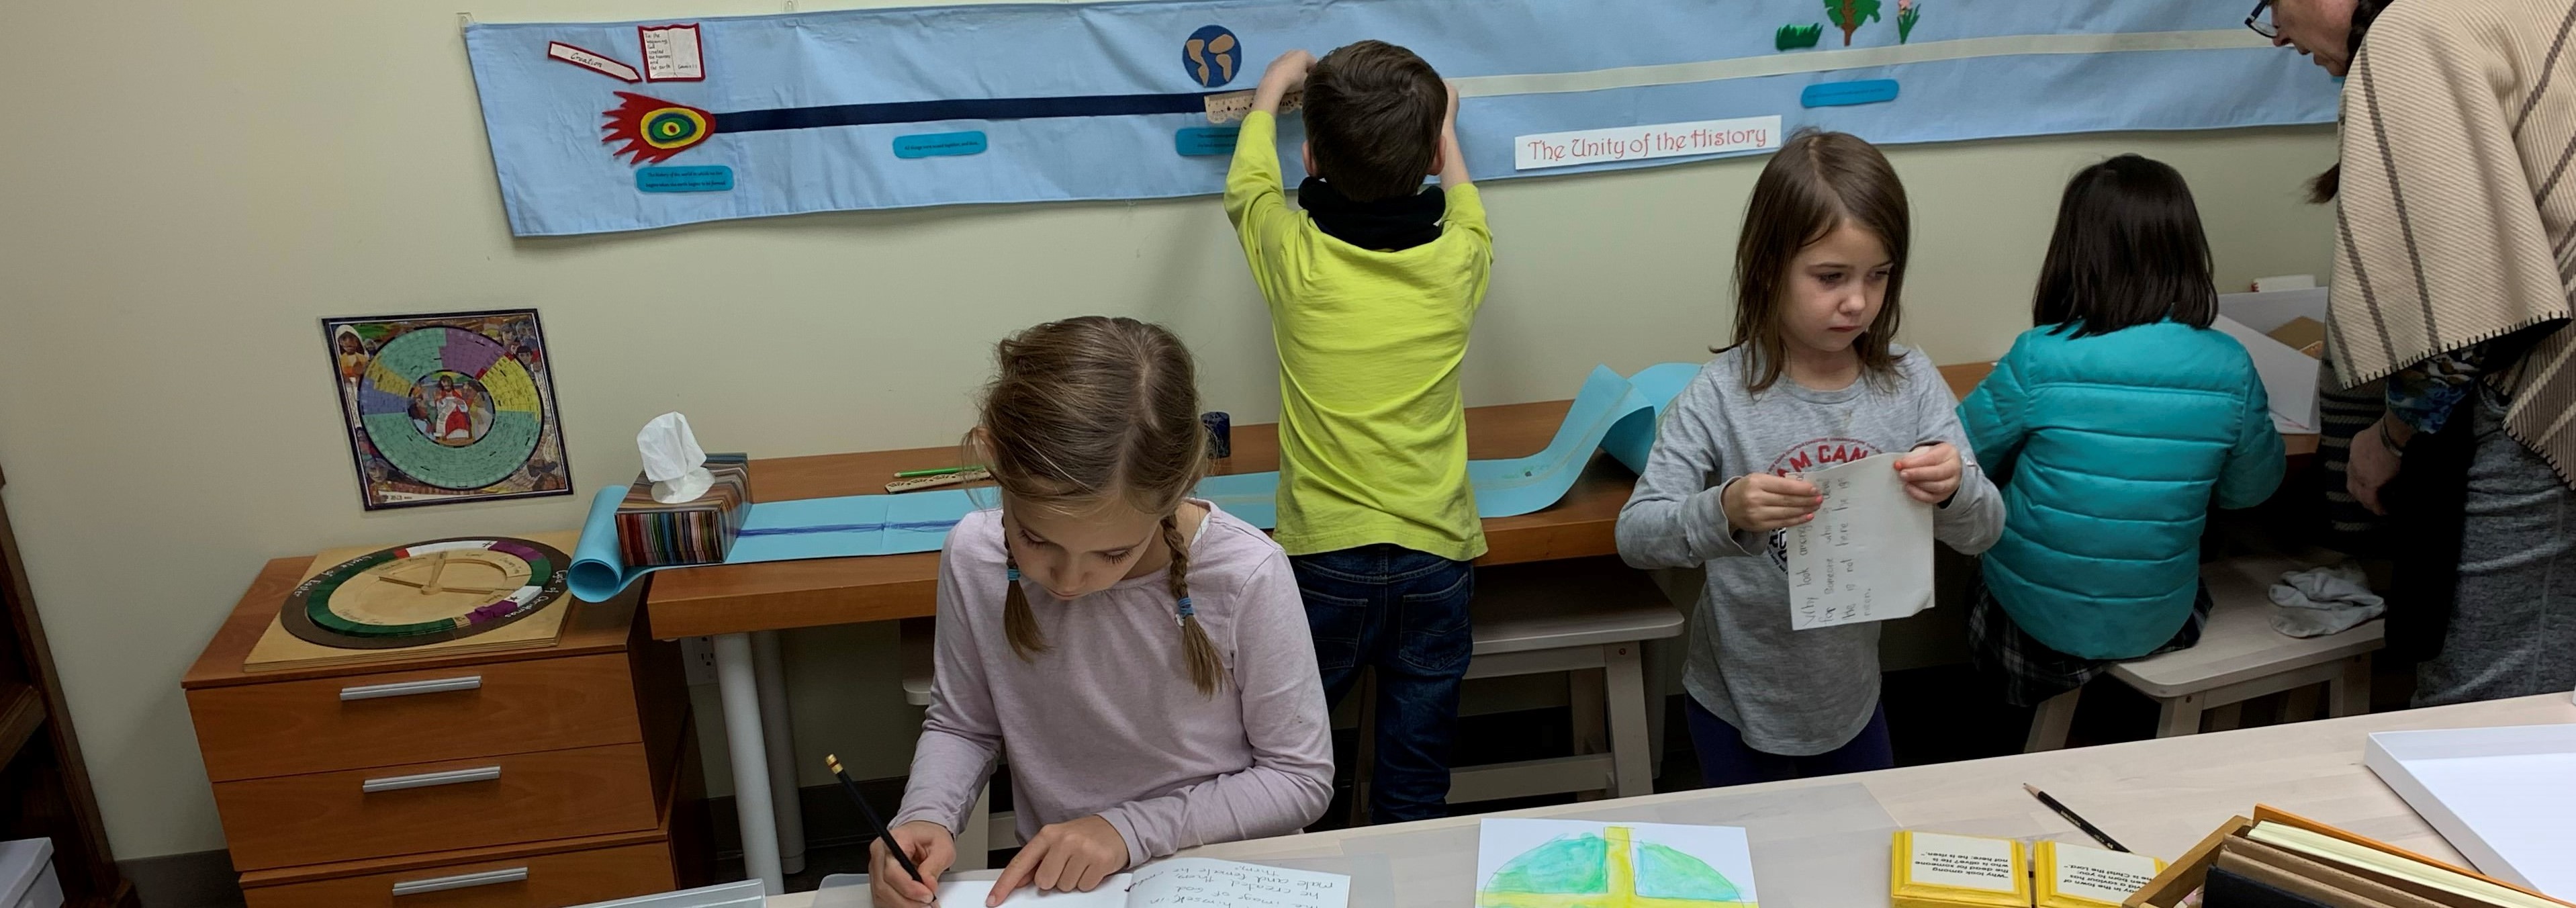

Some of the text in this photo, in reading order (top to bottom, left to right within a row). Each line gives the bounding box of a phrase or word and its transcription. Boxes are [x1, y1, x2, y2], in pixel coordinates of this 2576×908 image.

[570, 52, 602, 68] Creation
[1528, 128, 1767, 162] The Unity of the History
[1818, 445, 1868, 463] CAN
[1835, 523, 1849, 547] here
[1840, 559, 1853, 573] not
[1796, 568, 1812, 587] look
[1199, 868, 1246, 881] female
[1932, 867, 1964, 875] among
[2107, 870, 2130, 878] Christ
[1256, 876, 1289, 884] and
[2074, 880, 2096, 889] town
[2086, 878, 2117, 886] saviour
[2109, 875, 2128, 883] born
[1231, 880, 1291, 894] created
[1296, 880, 1333, 891] male
[1211, 891, 1230, 899] of
[1237, 893, 1279, 905] image
[1299, 891, 1318, 901] he
